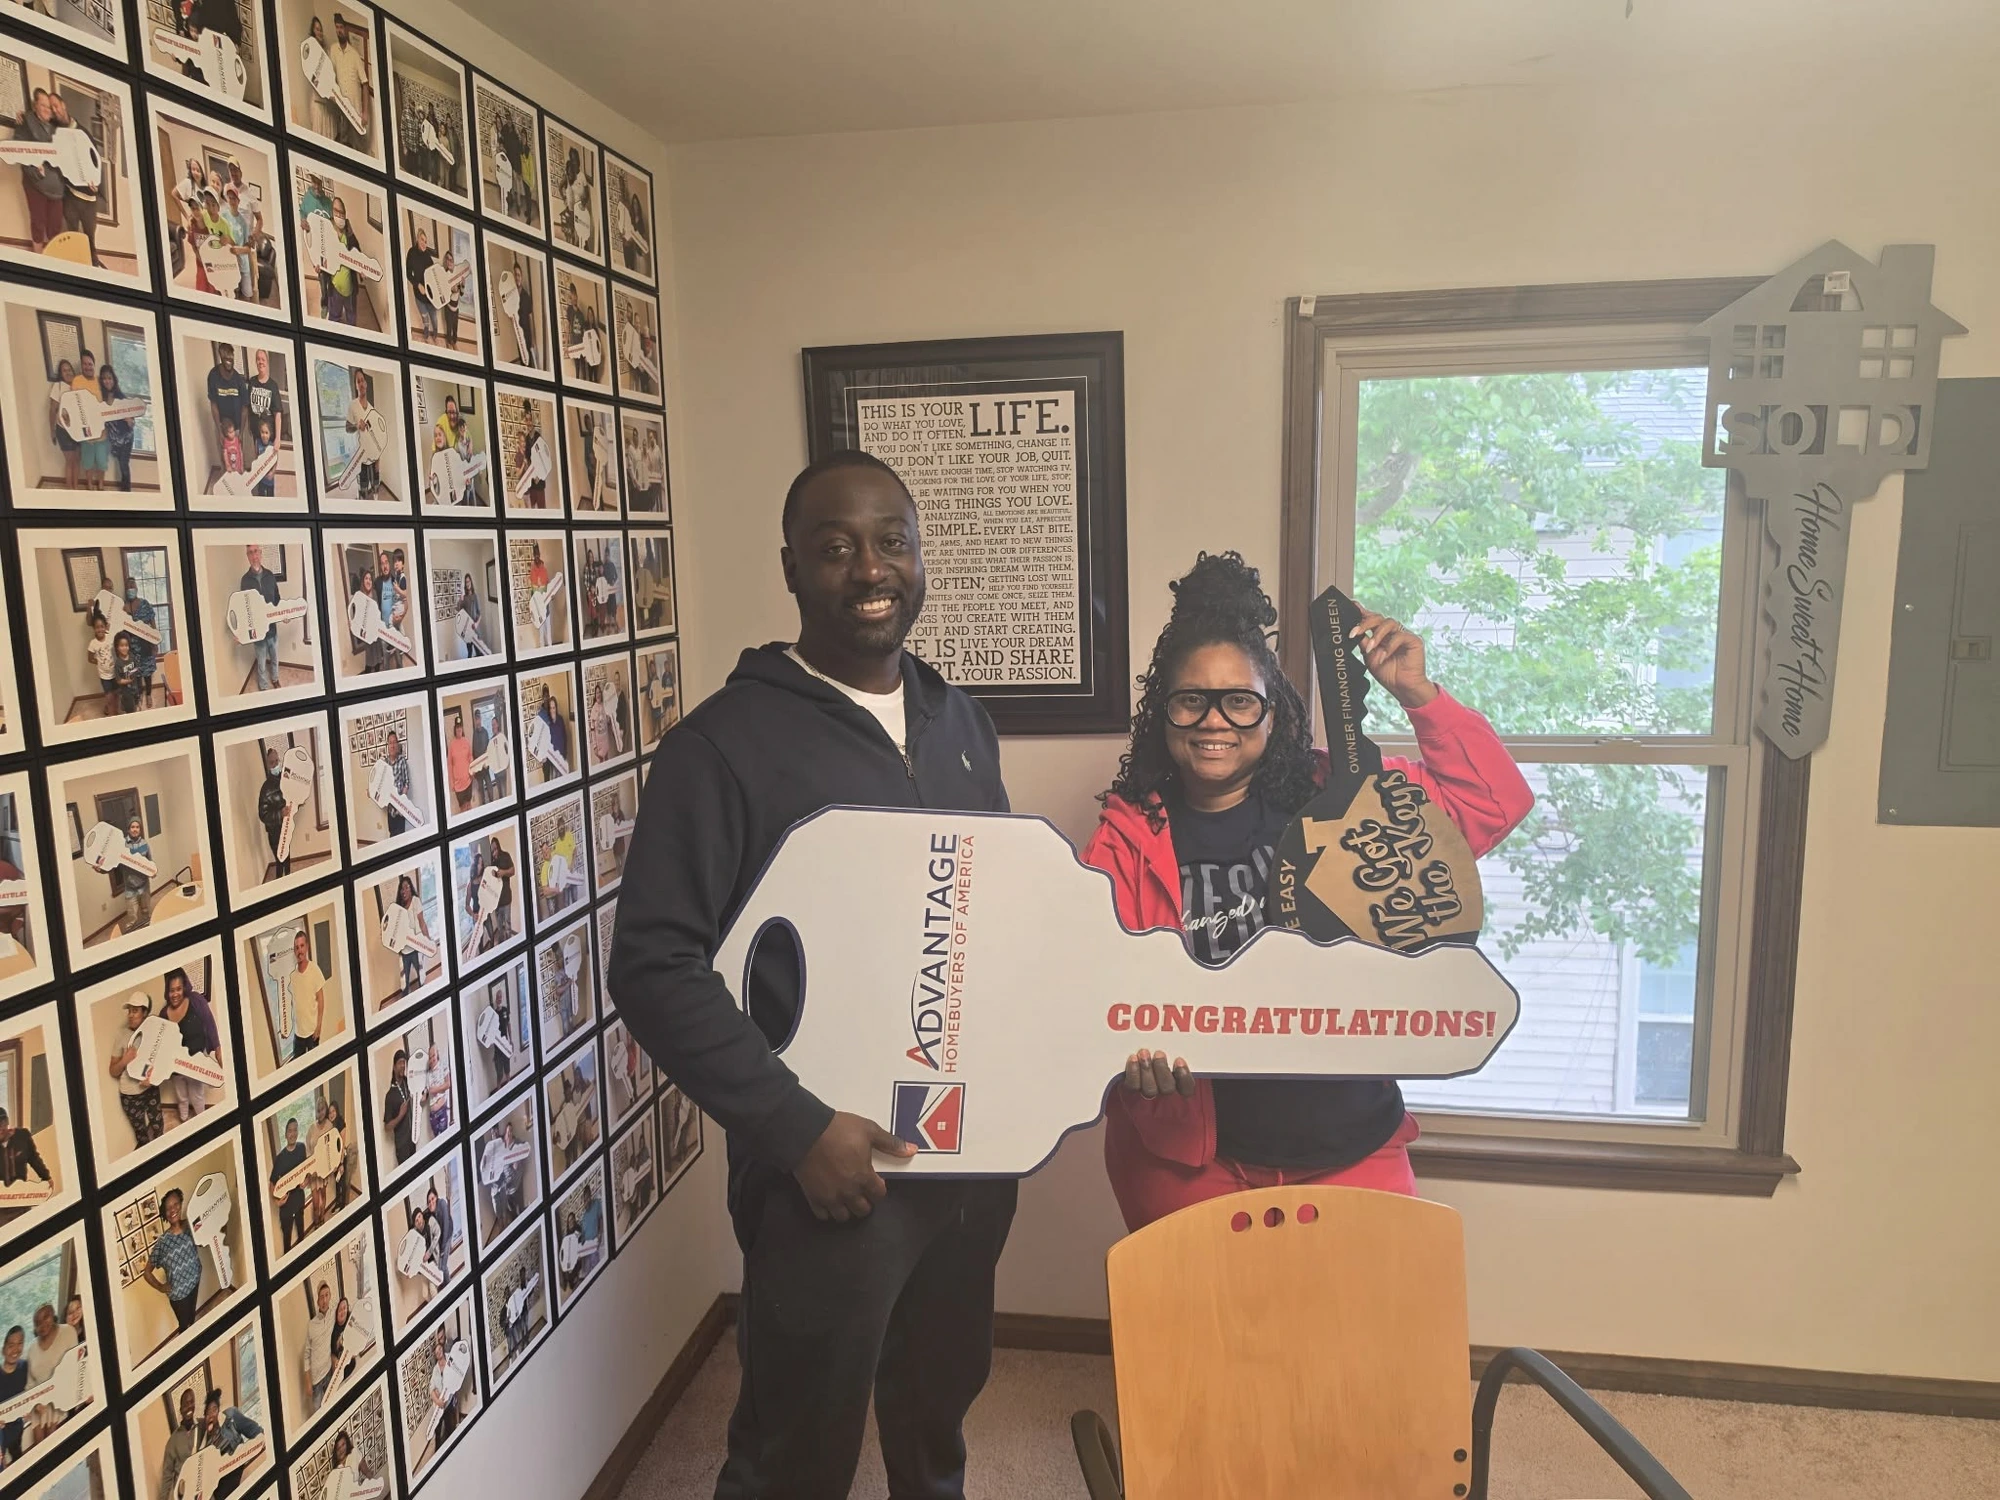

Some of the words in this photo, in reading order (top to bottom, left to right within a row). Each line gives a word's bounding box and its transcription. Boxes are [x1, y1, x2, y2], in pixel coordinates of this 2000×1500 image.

[861, 404, 897, 419] THIS
[901, 403, 916, 418] IS
[920, 401, 964, 417] YOUR
[969, 398, 1070, 437] LIFE.
[863, 422, 879, 431] DO
[882, 421, 912, 430] WHAT
[914, 420, 935, 429] YOU
[938, 419, 966, 429] LOVE,
[864, 432, 888, 442] AND
[891, 431, 909, 441] DO
[913, 431, 923, 441] IT
[927, 429, 966, 440] OFTEN.
[1718, 404, 1916, 455] SOLD
[864, 445, 874, 455] IF
[877, 444, 896, 454] YOU
[899, 441, 929, 453] DON'T
[932, 442, 953, 452] LIKE
[955, 440, 1015, 451] SOMETHING,
[1016, 438, 1057, 449] CHANGE
[1061, 438, 1071, 447] IT.
[907, 452, 944, 466] DON'T
[948, 453, 975, 465] LIKE
[978, 452, 1010, 464] YOUR
[1015, 451, 1039, 463] JOB,
[1041, 450, 1071, 462] QUIT.
[894, 467, 916, 477] ON'T
[918, 468, 939, 476] HAVE
[941, 467, 972, 476] ENOUGH
[974, 467, 995, 475] TIME,
[996, 466, 1015, 474] STOP
[1016, 465, 1058, 473] WATCHING
[1060, 464, 1072, 472] TV.
[909, 477, 942, 486] LOOKING
[944, 476, 958, 484] FOR
[960, 476, 975, 484] THE
[976, 475, 995, 483] LOVE
[997, 475, 1008, 483] OF
[1009, 474, 1029, 482] YOUR
[919, 488, 930, 497] BE
[933, 487, 974, 497] WAITING
[977, 486, 995, 495] FOR
[997, 486, 1017, 495] YOU
[1019, 484, 1049, 494] WHEN
[1052, 484, 1071, 493] YOU
[915, 499, 950, 511] OING
[954, 497, 1002, 510] THINGS
[1006, 496, 1032, 508] YOU
[1037, 495, 1073, 507] LOVE.
[924, 511, 980, 521] ANALYZING,
[926, 523, 982, 537] SIMPLE.
[983, 526, 1016, 536] EVERY
[1020, 525, 1044, 535] LAST
[1048, 524, 1074, 534] BITE.
[1793, 482, 1843, 571] Home
[984, 538, 1008, 546] HEART
[1023, 537, 1042, 545] NEW
[1044, 536, 1073, 544] THINGS
[923, 549, 937, 557] WE
[956, 548, 986, 556] UNITED
[1000, 547, 1017, 555] OUR
[1019, 546, 1074, 554] DIFFERENCES.
[970, 557, 983, 565] SEE
[1009, 556, 1030, 564] THEIR
[946, 566, 988, 574] INSPIRING
[990, 565, 1019, 573] DREAM
[1022, 564, 1045, 572] WITH
[1048, 564, 1074, 572] THEM.
[988, 575, 1025, 583] GETTING
[1028, 574, 1049, 582] LOST
[954, 593, 975, 601] ONLY
[1051, 591, 1075, 599] THEM.
[941, 604, 960, 612] THE
[962, 603, 996, 611] PEOPLE
[998, 602, 1018, 611] YOU
[1021, 602, 1049, 610] MEET,
[1053, 601, 1074, 610] AND
[1787, 564, 1834, 662] Sweet
[941, 614, 963, 623] YOU
[966, 613, 1007, 623] CREATE
[1010, 613, 1040, 622] WITH
[1044, 612, 1074, 621] THEM
[1328, 599, 1343, 645] QUEEN
[915, 626, 939, 637] OUT
[943, 626, 970, 636] AND
[974, 625, 1008, 636] START
[1012, 624, 1076, 635] CREATING.
[935, 639, 956, 658] IS
[960, 639, 989, 649] LIVE
[992, 638, 1026, 648] YOUR
[1029, 637, 1074, 648] DREAM
[961, 650, 1004, 666] AND
[1010, 649, 1074, 665] SHARE
[961, 668, 1004, 681] YOUR
[1008, 667, 1076, 680] PASSION.
[1335, 648, 1353, 720] FINANCING
[1777, 653, 1826, 738] Home
[1344, 723, 1360, 774] OWNER
[1382, 772, 1431, 874] Keys
[1347, 822, 1402, 887] Get
[956, 835, 975, 916] AMERICA
[1280, 859, 1296, 913] EASY
[1422, 864, 1461, 921] the
[1376, 890, 1425, 950] We
[956, 921, 968, 945] OF
[906, 834, 958, 1072] ADVANTAGE
[945, 951, 965, 1073] HOMEBUYERS
[1106, 1003, 1497, 1038] CONGRATULATIONS!
